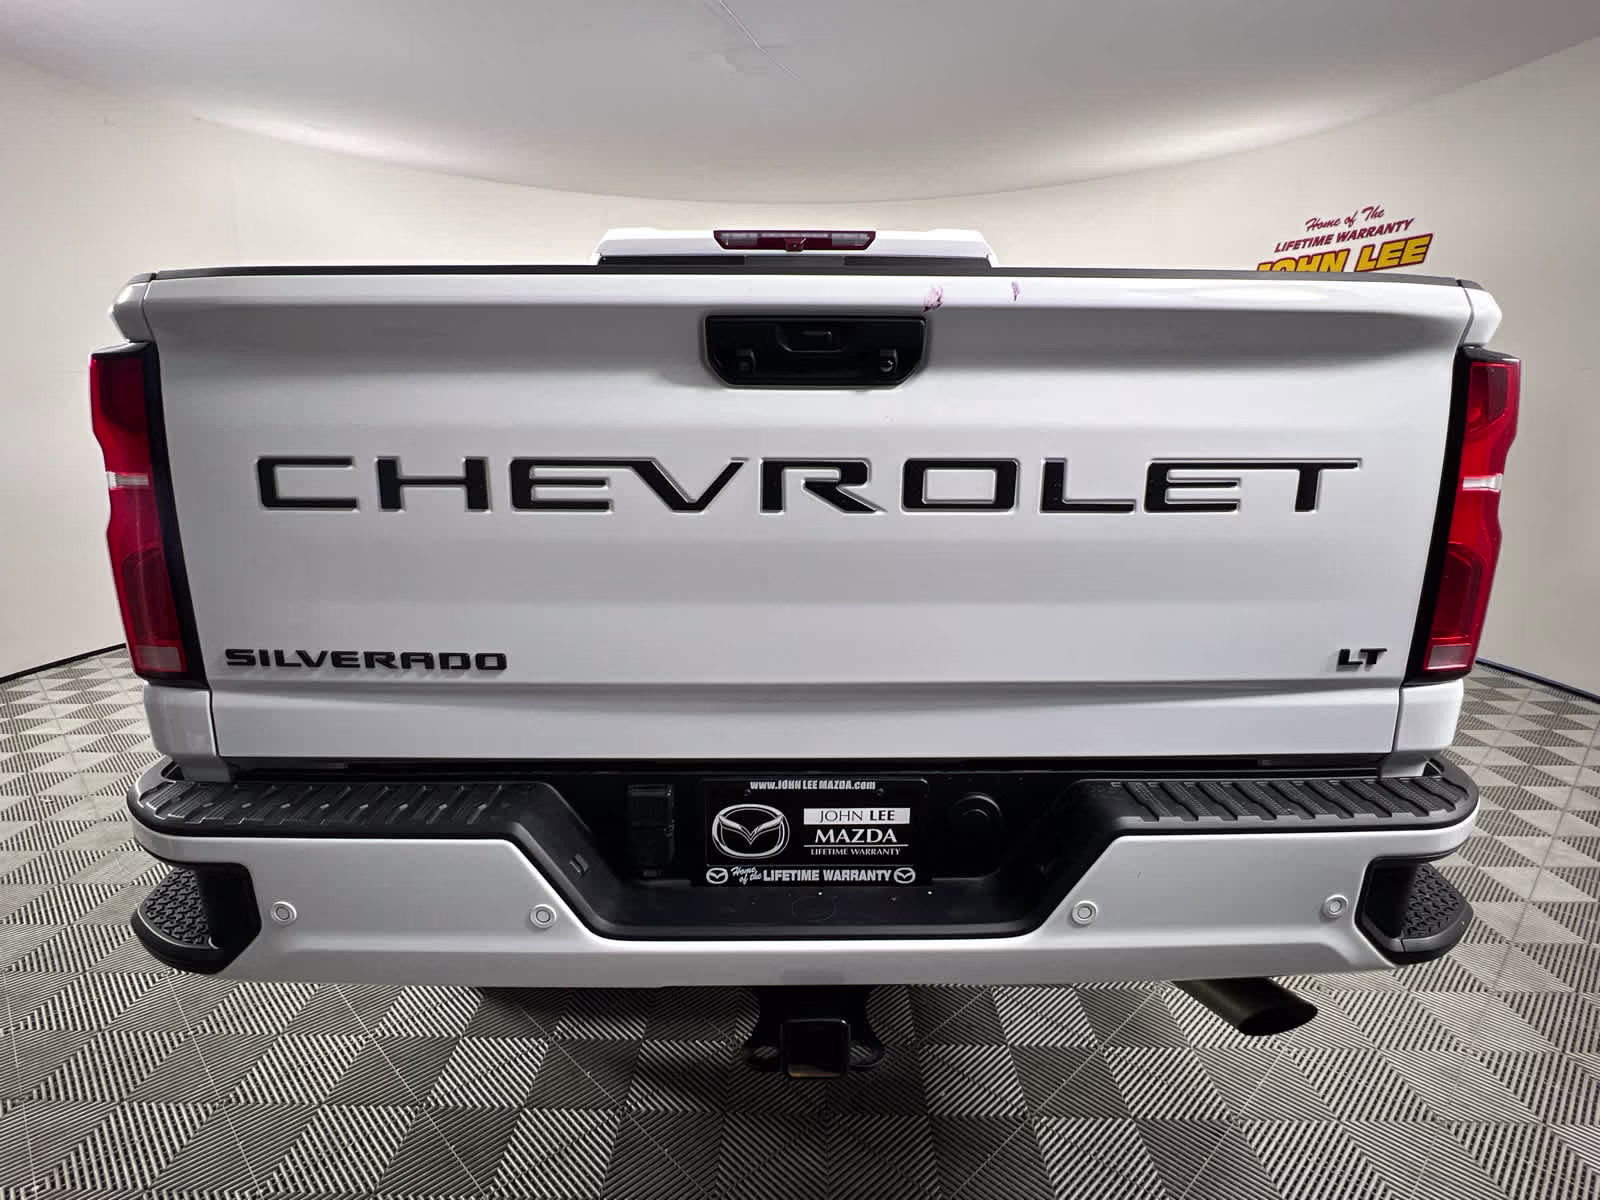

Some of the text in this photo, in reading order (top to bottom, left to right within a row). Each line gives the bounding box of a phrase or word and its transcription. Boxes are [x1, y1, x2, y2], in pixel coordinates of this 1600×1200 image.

[1305, 205, 1384, 232] Home of The
[1274, 218, 1414, 253] LIFETIME WARRANTY
[1353, 233, 1433, 272] LEE
[255, 456, 1362, 514] CHEVROLET
[225, 648, 507, 671] SILVERADO
[1336, 648, 1387, 666] LT
[820, 810, 895, 823] JOHN LEE
[815, 828, 898, 843] MAZDA
[811, 847, 901, 856] LIFETIME WARRANTY
[763, 869, 892, 882] LIFETIME WARRANTY
